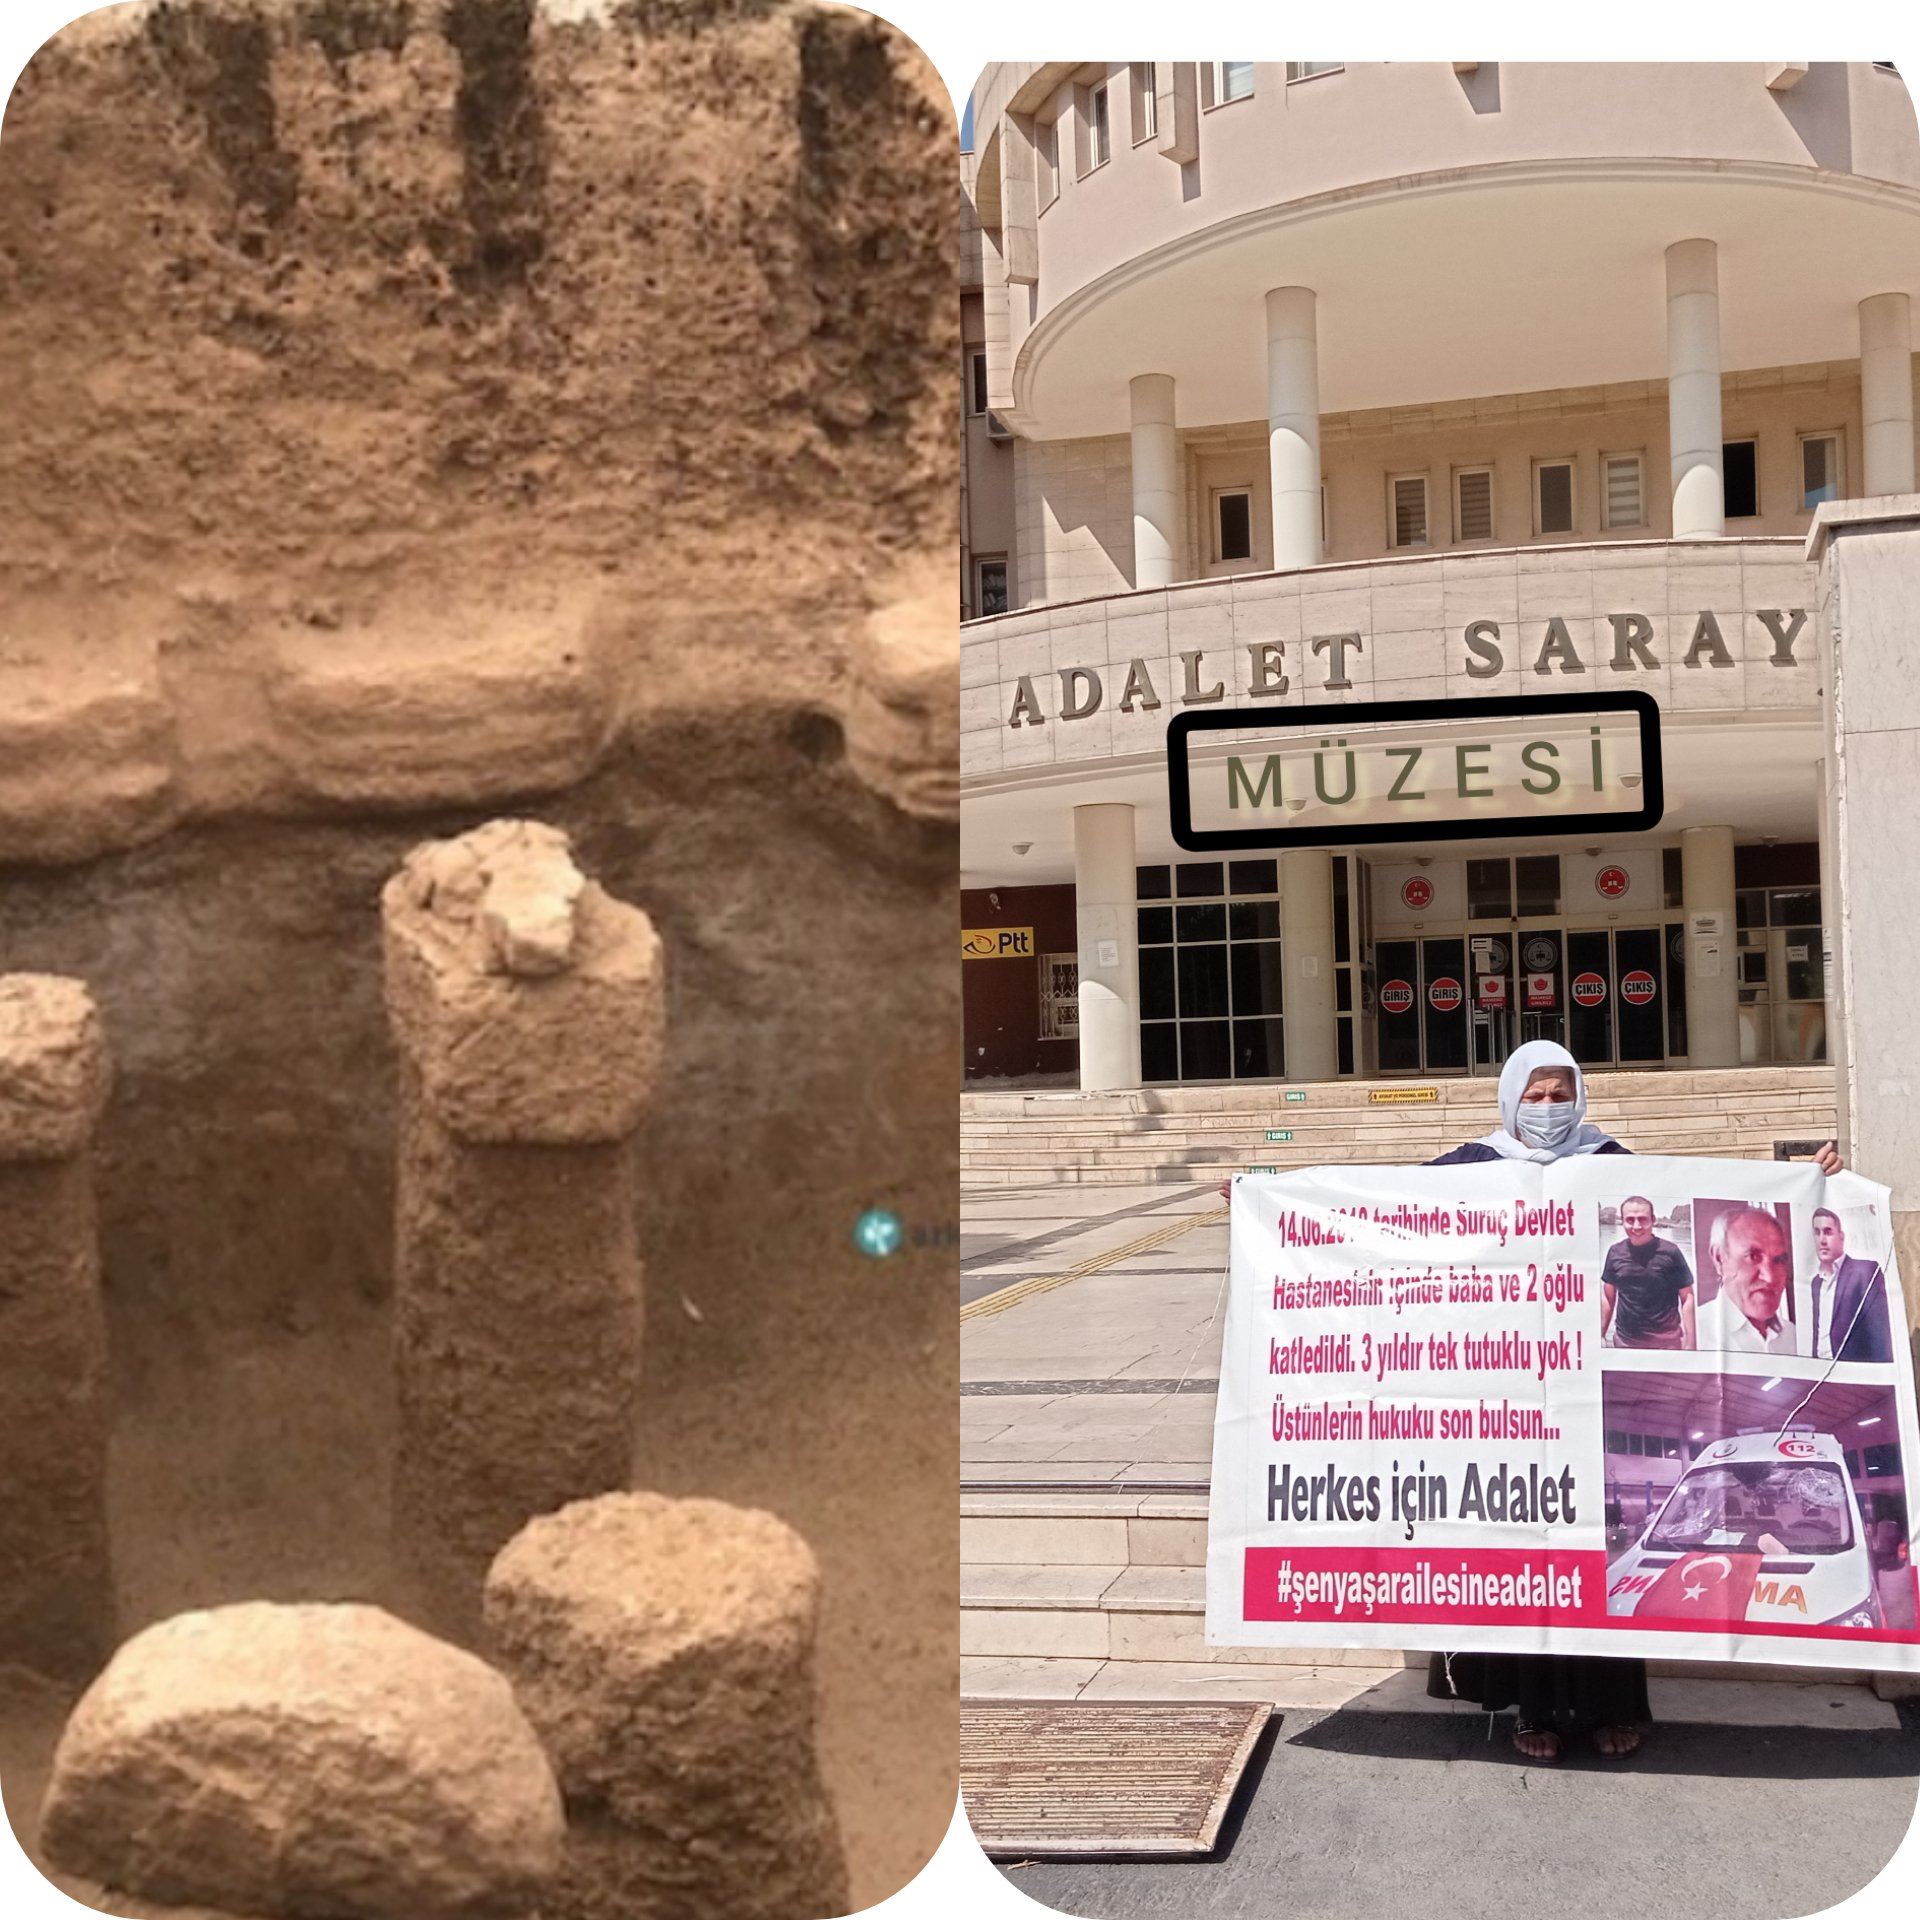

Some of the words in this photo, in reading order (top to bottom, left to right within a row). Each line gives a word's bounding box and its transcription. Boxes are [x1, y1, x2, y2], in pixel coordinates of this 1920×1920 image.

[1008, 631, 1363, 728] ADALET
[1464, 608, 1808, 679] SARAY
[998, 932, 1029, 954] Ptt
[1515, 1199, 1575, 1236] Devlet
[1449, 1265, 1494, 1304] baba
[1499, 1274, 1521, 1302] ve
[1526, 1263, 1538, 1302] 2
[1543, 1263, 1585, 1313] oğlu
[1269, 1334, 1356, 1375] katledildi.
[1361, 1333, 1372, 1373] 3
[1377, 1332, 1424, 1383] yıldır
[1429, 1331, 1459, 1371] tek
[1464, 1331, 1532, 1371] tutuklu
[1272, 1393, 1363, 1442] Üstünlerin
[1369, 1400, 1434, 1440] hukuku
[1440, 1408, 1473, 1440] son
[1267, 1463, 1381, 1522] Herkes
[1391, 1459, 1448, 1541] için
[1458, 1462, 1577, 1524] Adalet
[1277, 1559, 1583, 1616] #şenyaşarailesineadalet
